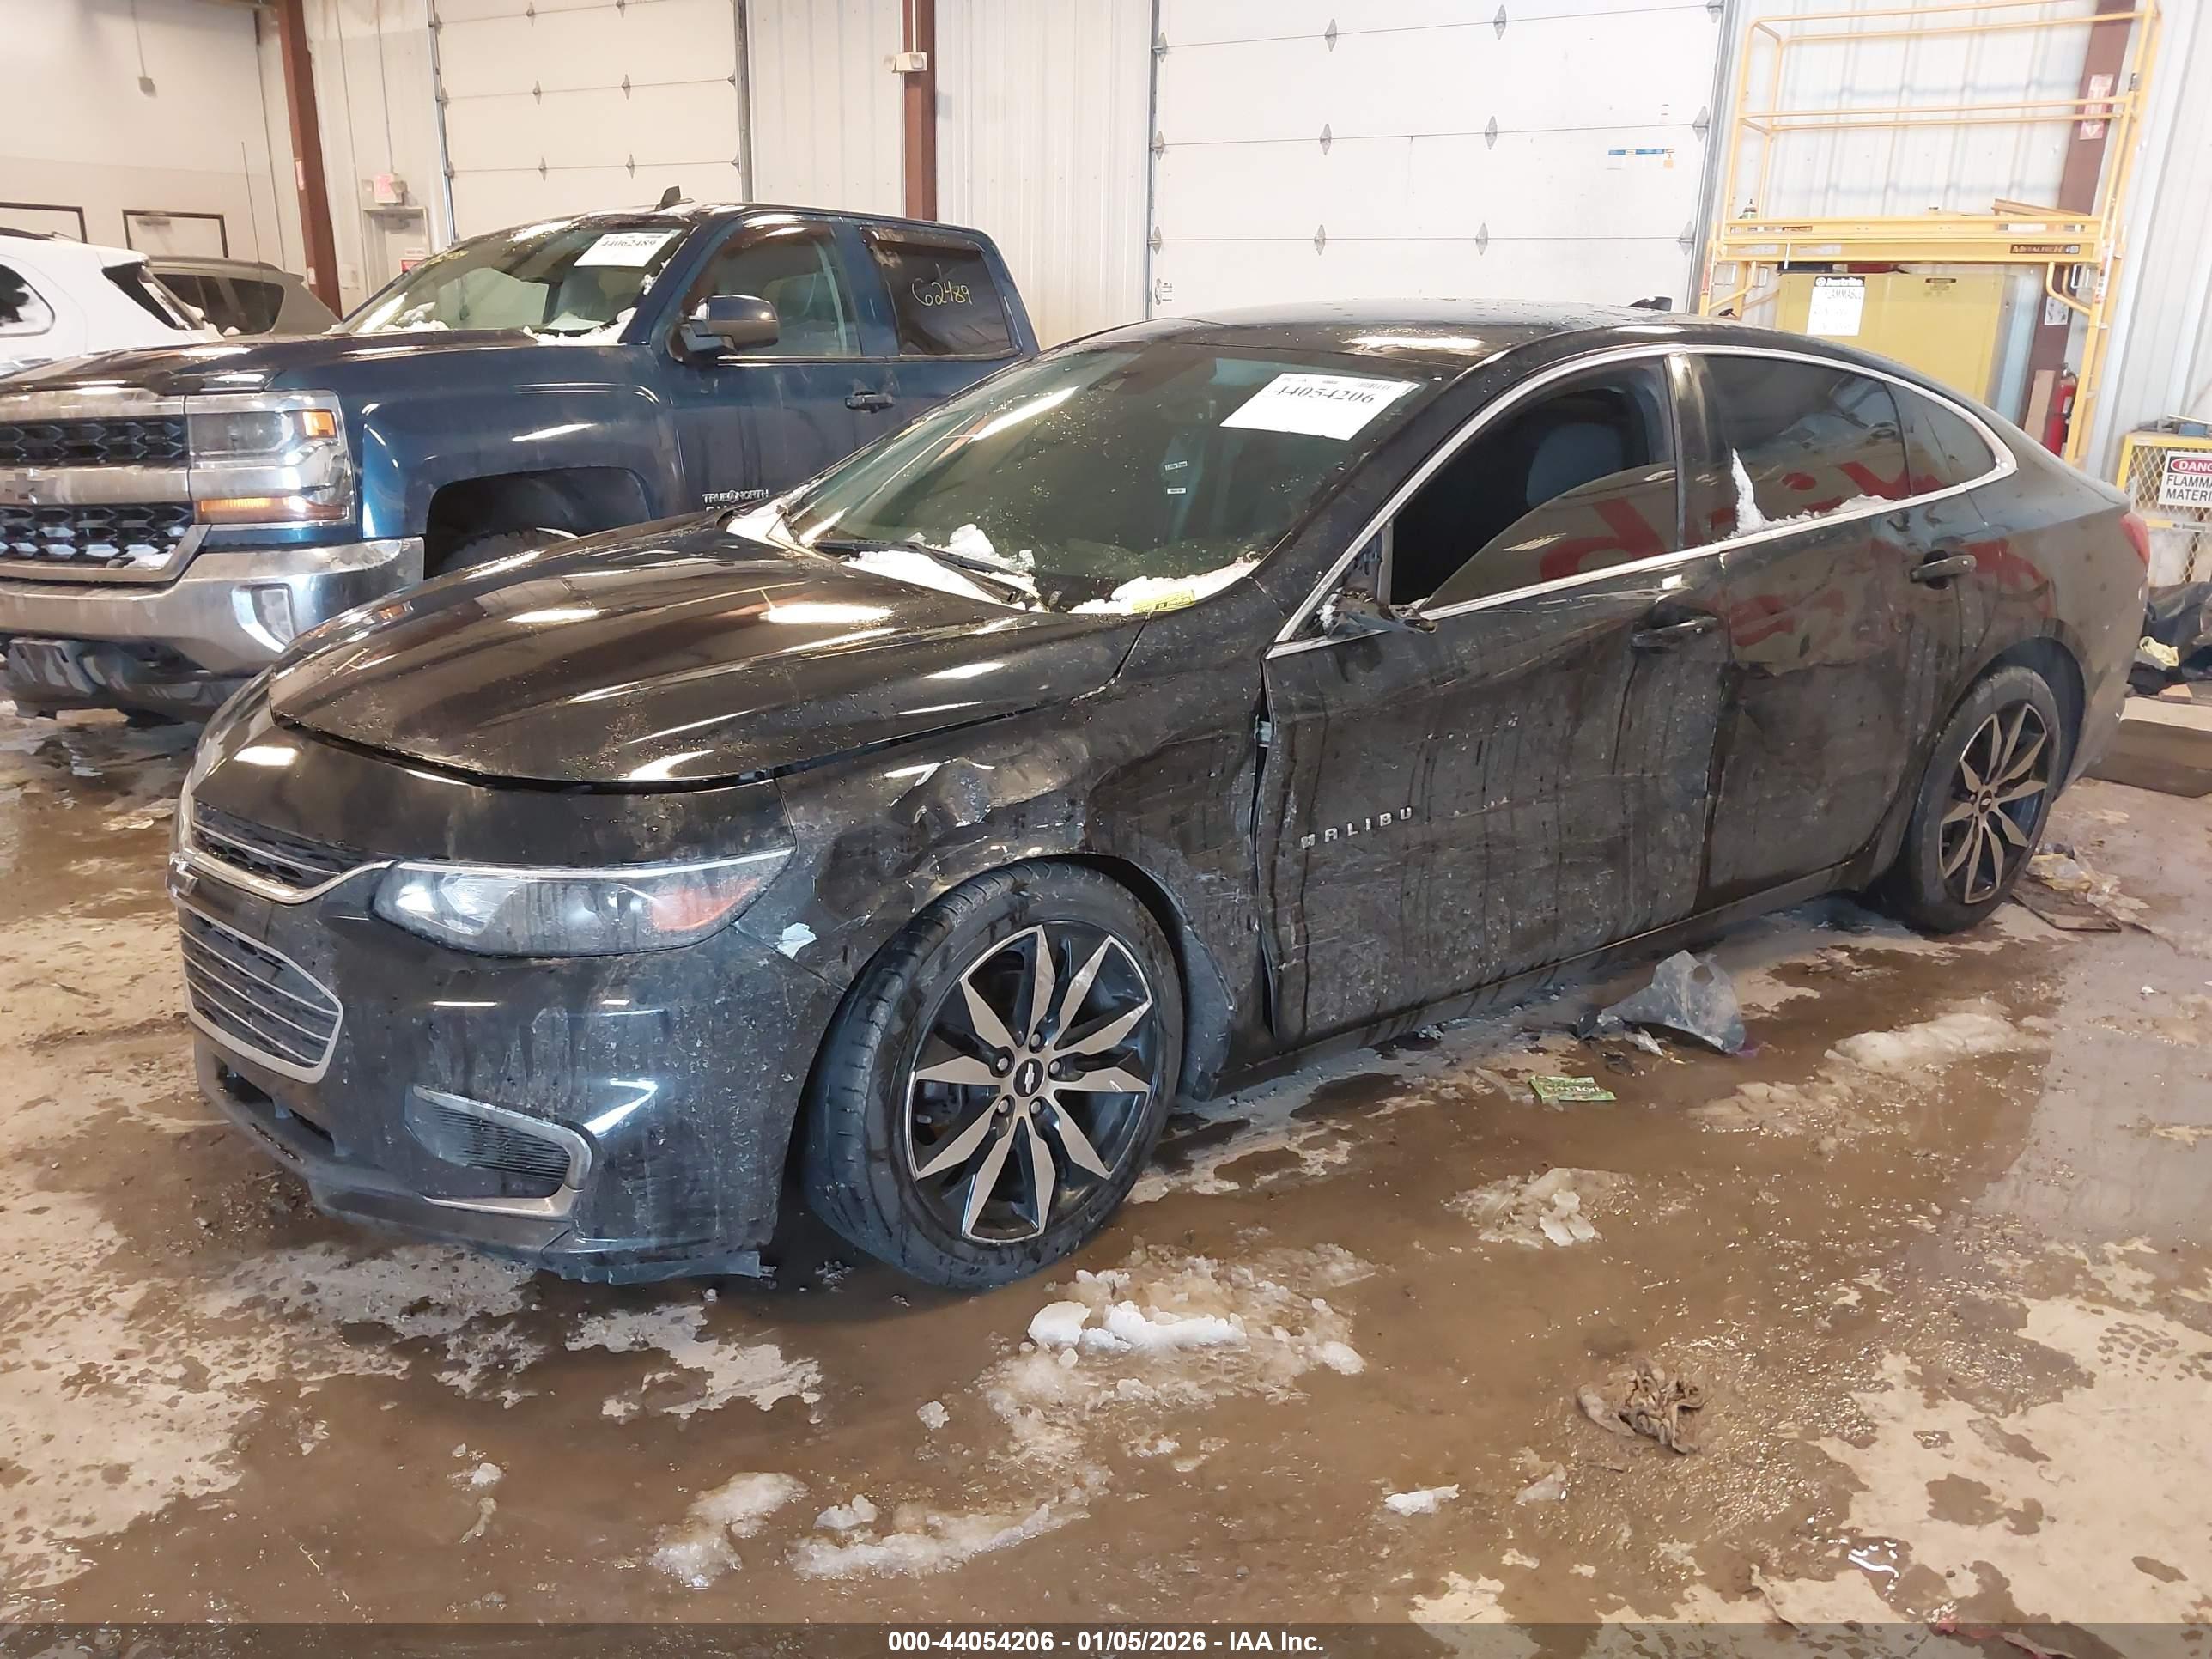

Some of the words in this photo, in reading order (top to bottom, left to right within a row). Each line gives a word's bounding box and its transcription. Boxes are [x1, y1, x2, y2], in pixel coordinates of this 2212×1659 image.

[911, 278, 973, 307] 62489
[1273, 386, 1375, 404] 44054206
[738, 489, 769, 500] NORTH
[2166, 488, 2212, 501] MATERI
[1300, 806, 1413, 850] MALIBU
